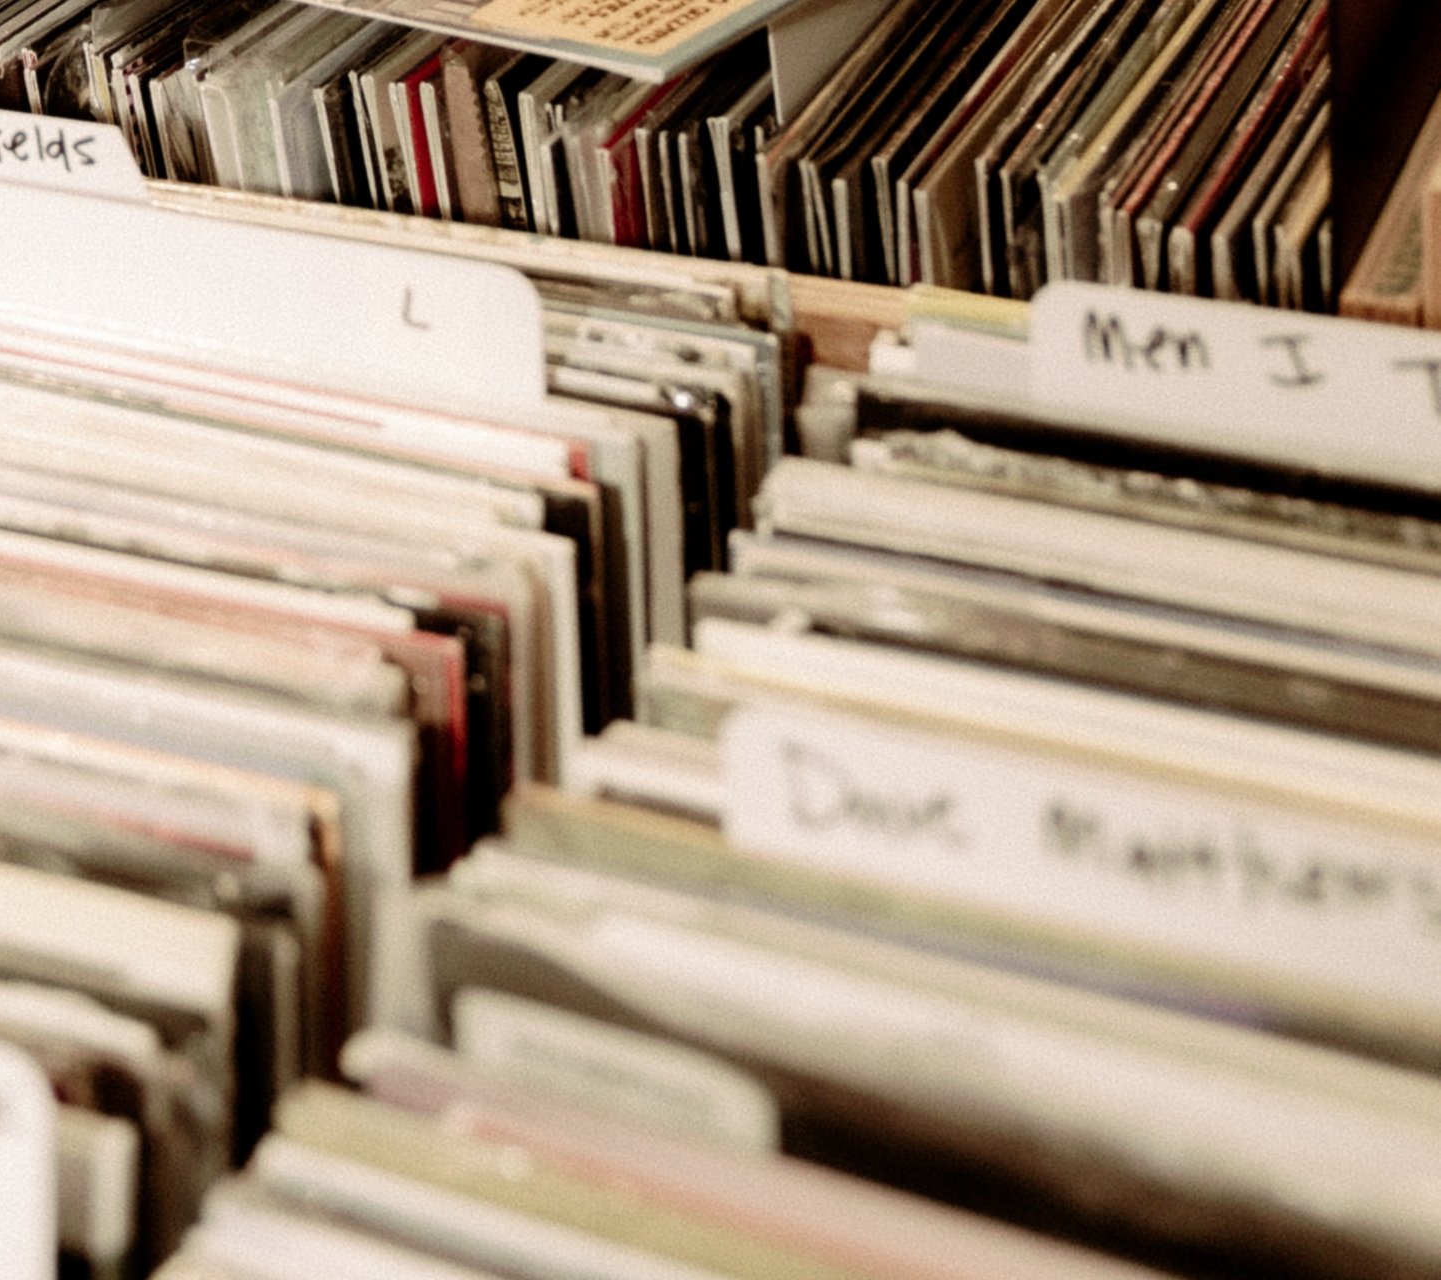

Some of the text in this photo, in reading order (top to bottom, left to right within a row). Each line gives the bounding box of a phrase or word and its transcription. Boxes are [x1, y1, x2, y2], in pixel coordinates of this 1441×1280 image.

[401, 286, 431, 331] L
[1082, 309, 1210, 372] Men
[1260, 333, 1325, 387] I
